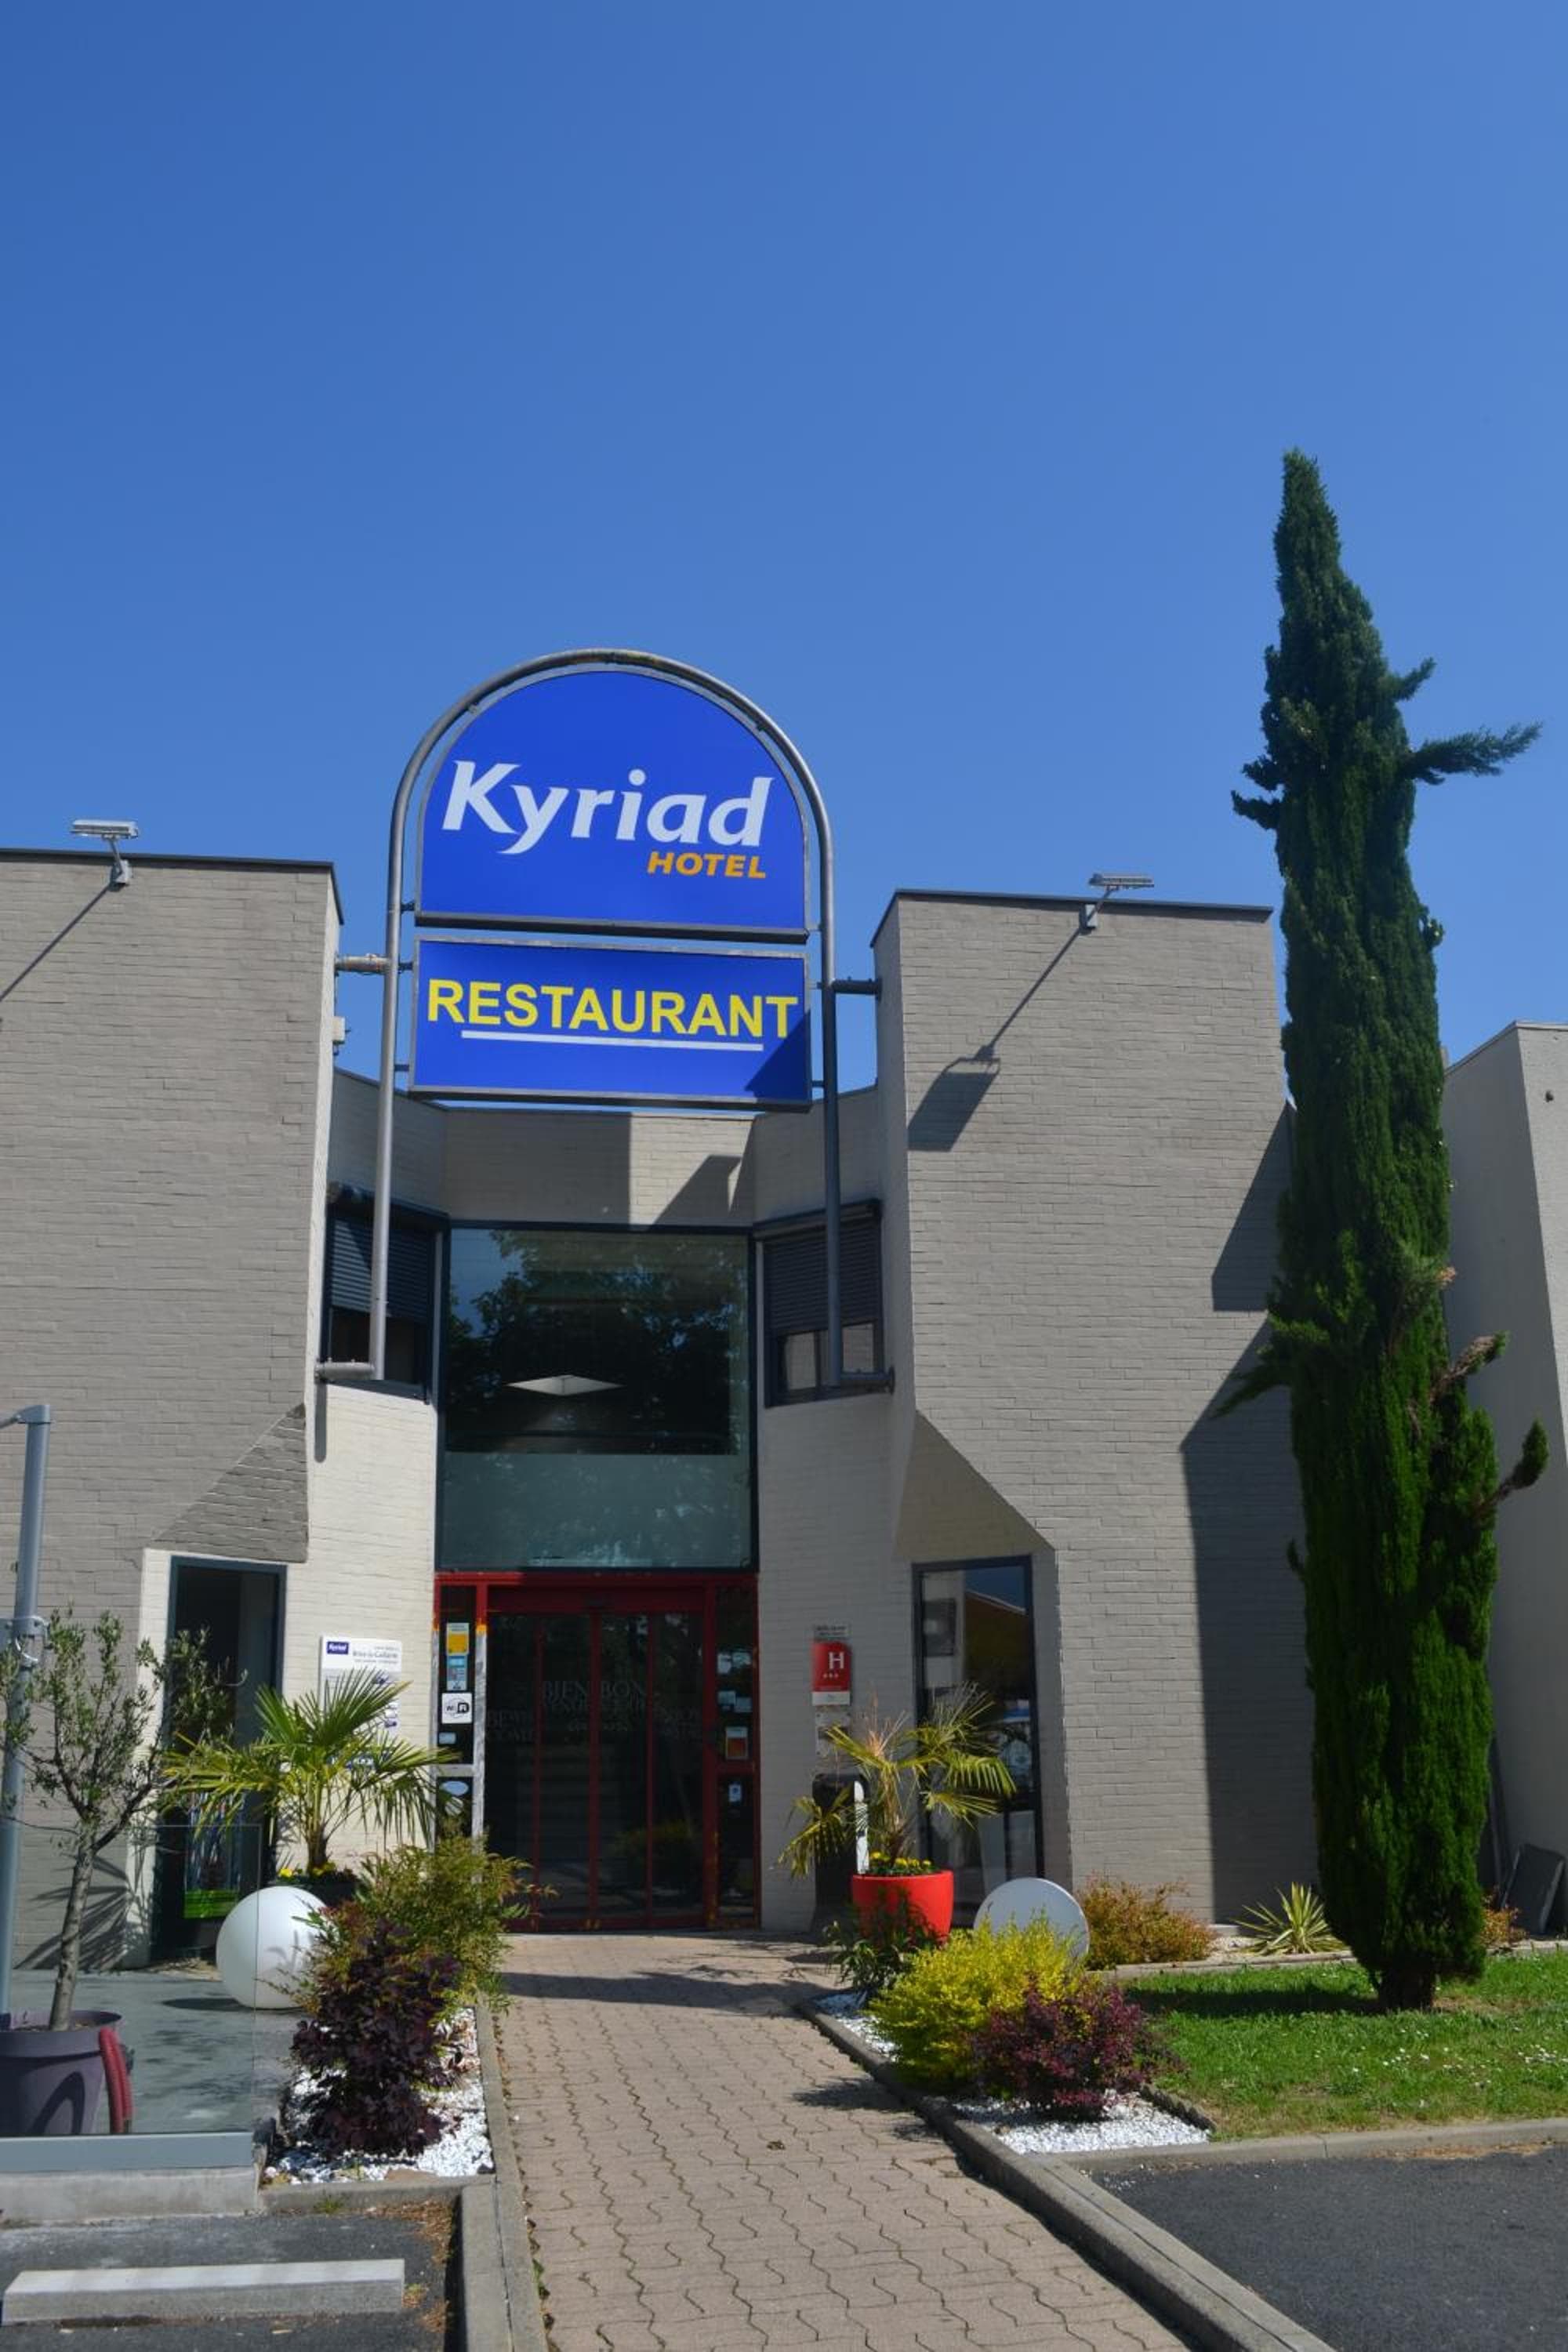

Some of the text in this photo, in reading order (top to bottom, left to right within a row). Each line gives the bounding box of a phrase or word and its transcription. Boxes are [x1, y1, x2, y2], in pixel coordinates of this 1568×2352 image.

[442, 760, 775, 855] Kyriad
[648, 851, 766, 878] HOTEL
[427, 978, 798, 1038] RESTAURANT
[829, 1652, 844, 1669] H
